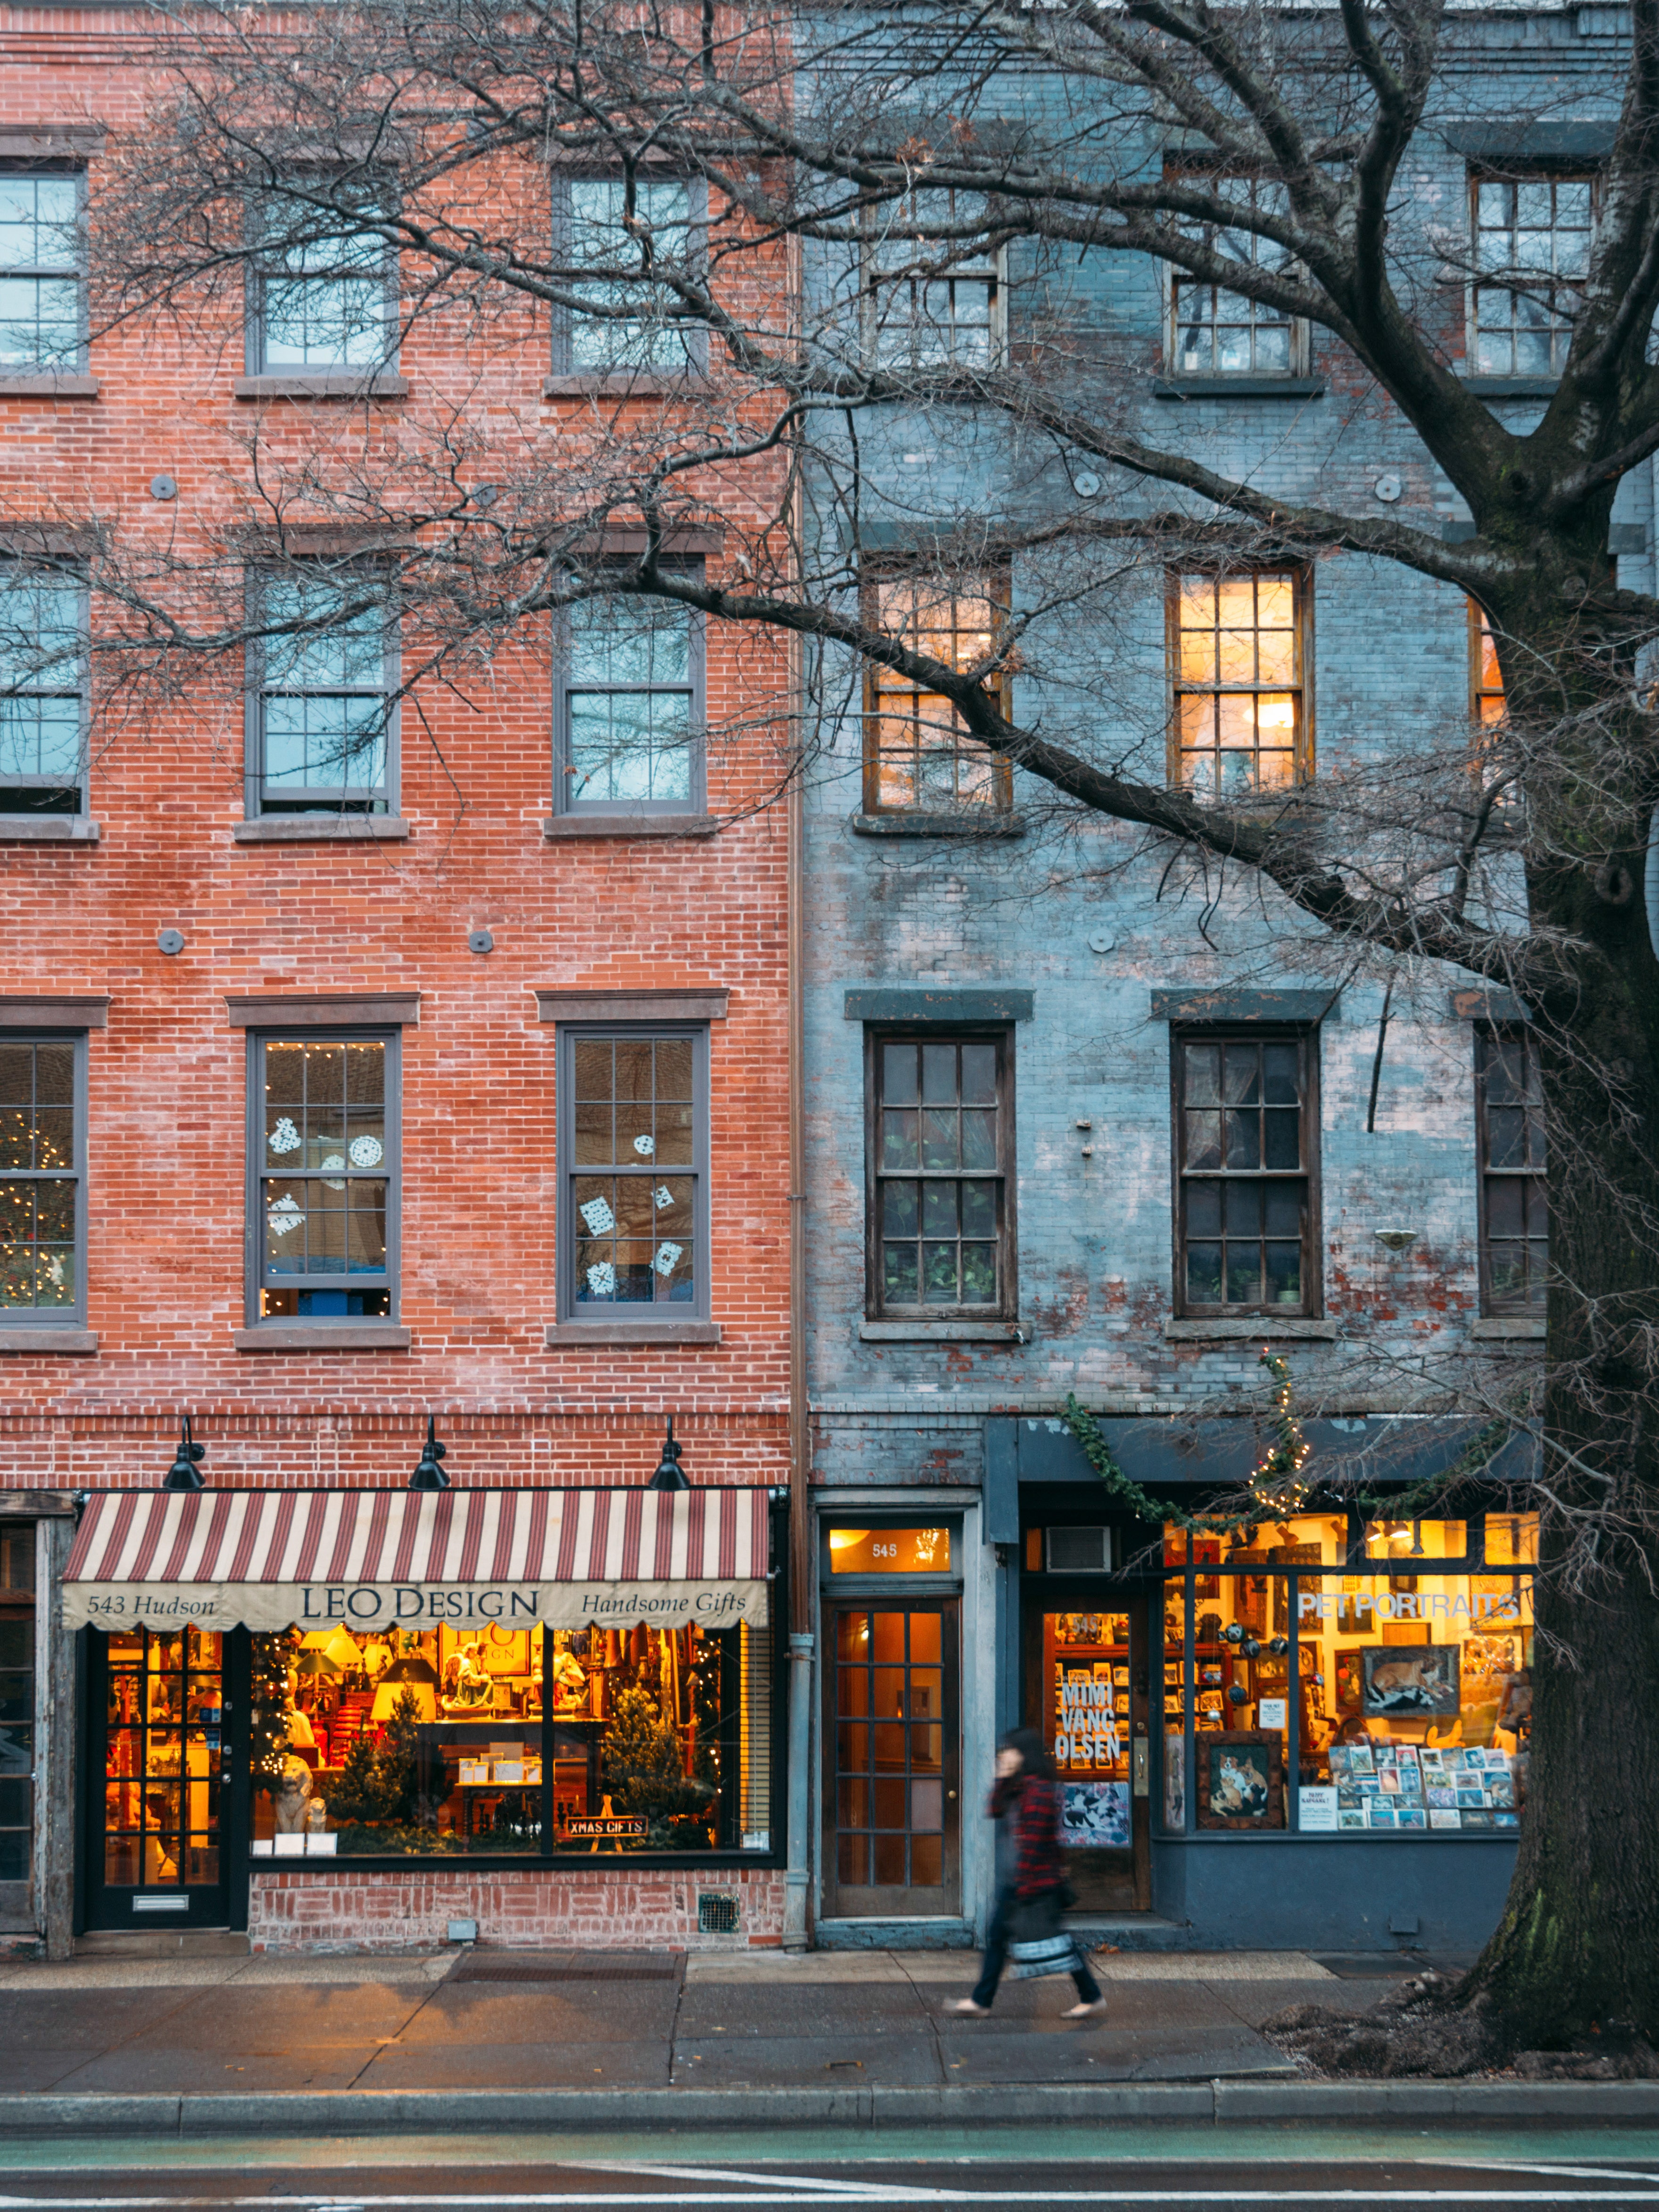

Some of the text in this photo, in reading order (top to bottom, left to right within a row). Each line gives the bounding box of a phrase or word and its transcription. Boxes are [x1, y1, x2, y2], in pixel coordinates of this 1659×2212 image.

[873, 1543, 897, 1558] 545
[87, 1596, 214, 1614] 543 Hudson
[301, 1588, 540, 1618] LEO DESIGN
[581, 1592, 746, 1617] Handsome Gifts
[1298, 1593, 1519, 1619] PET PORTRAITS
[1073, 1617, 1098, 1633] 545
[1062, 1682, 1112, 1706] MIMI
[1061, 1708, 1114, 1733] VANG
[1055, 1733, 1120, 1759] OLSEN
[570, 1820, 643, 1834] XMAS GIFTS
